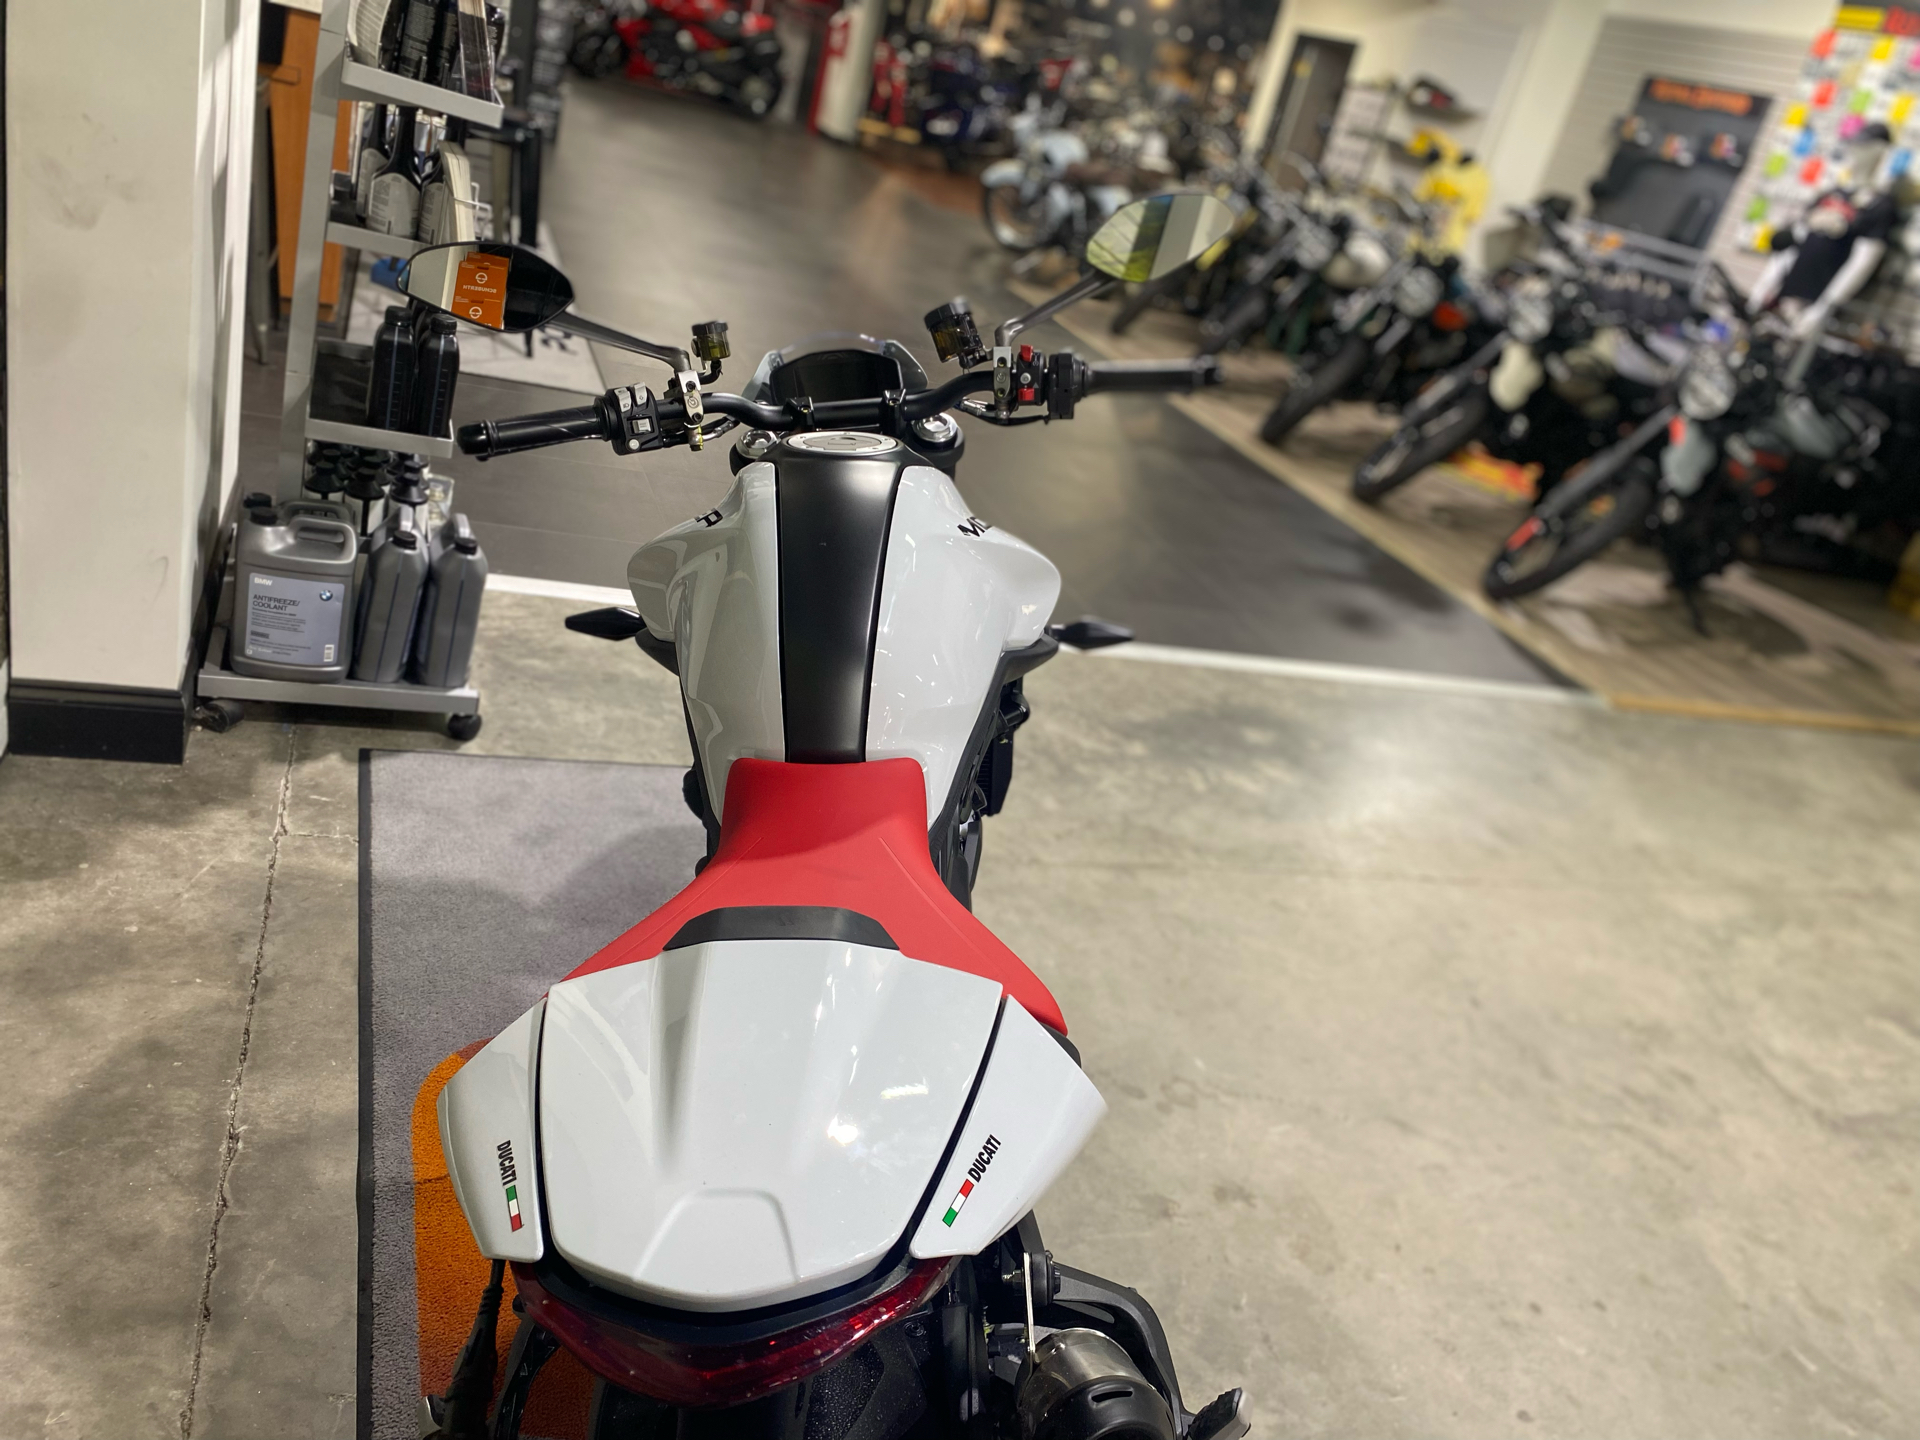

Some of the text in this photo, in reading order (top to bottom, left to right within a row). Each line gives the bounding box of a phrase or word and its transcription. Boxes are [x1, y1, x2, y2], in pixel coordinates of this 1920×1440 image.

[254, 577, 273, 586] BMW
[252, 601, 288, 612] COOLANT
[497, 1140, 517, 1186] DUCATI
[966, 1134, 1001, 1183] DUCATI
